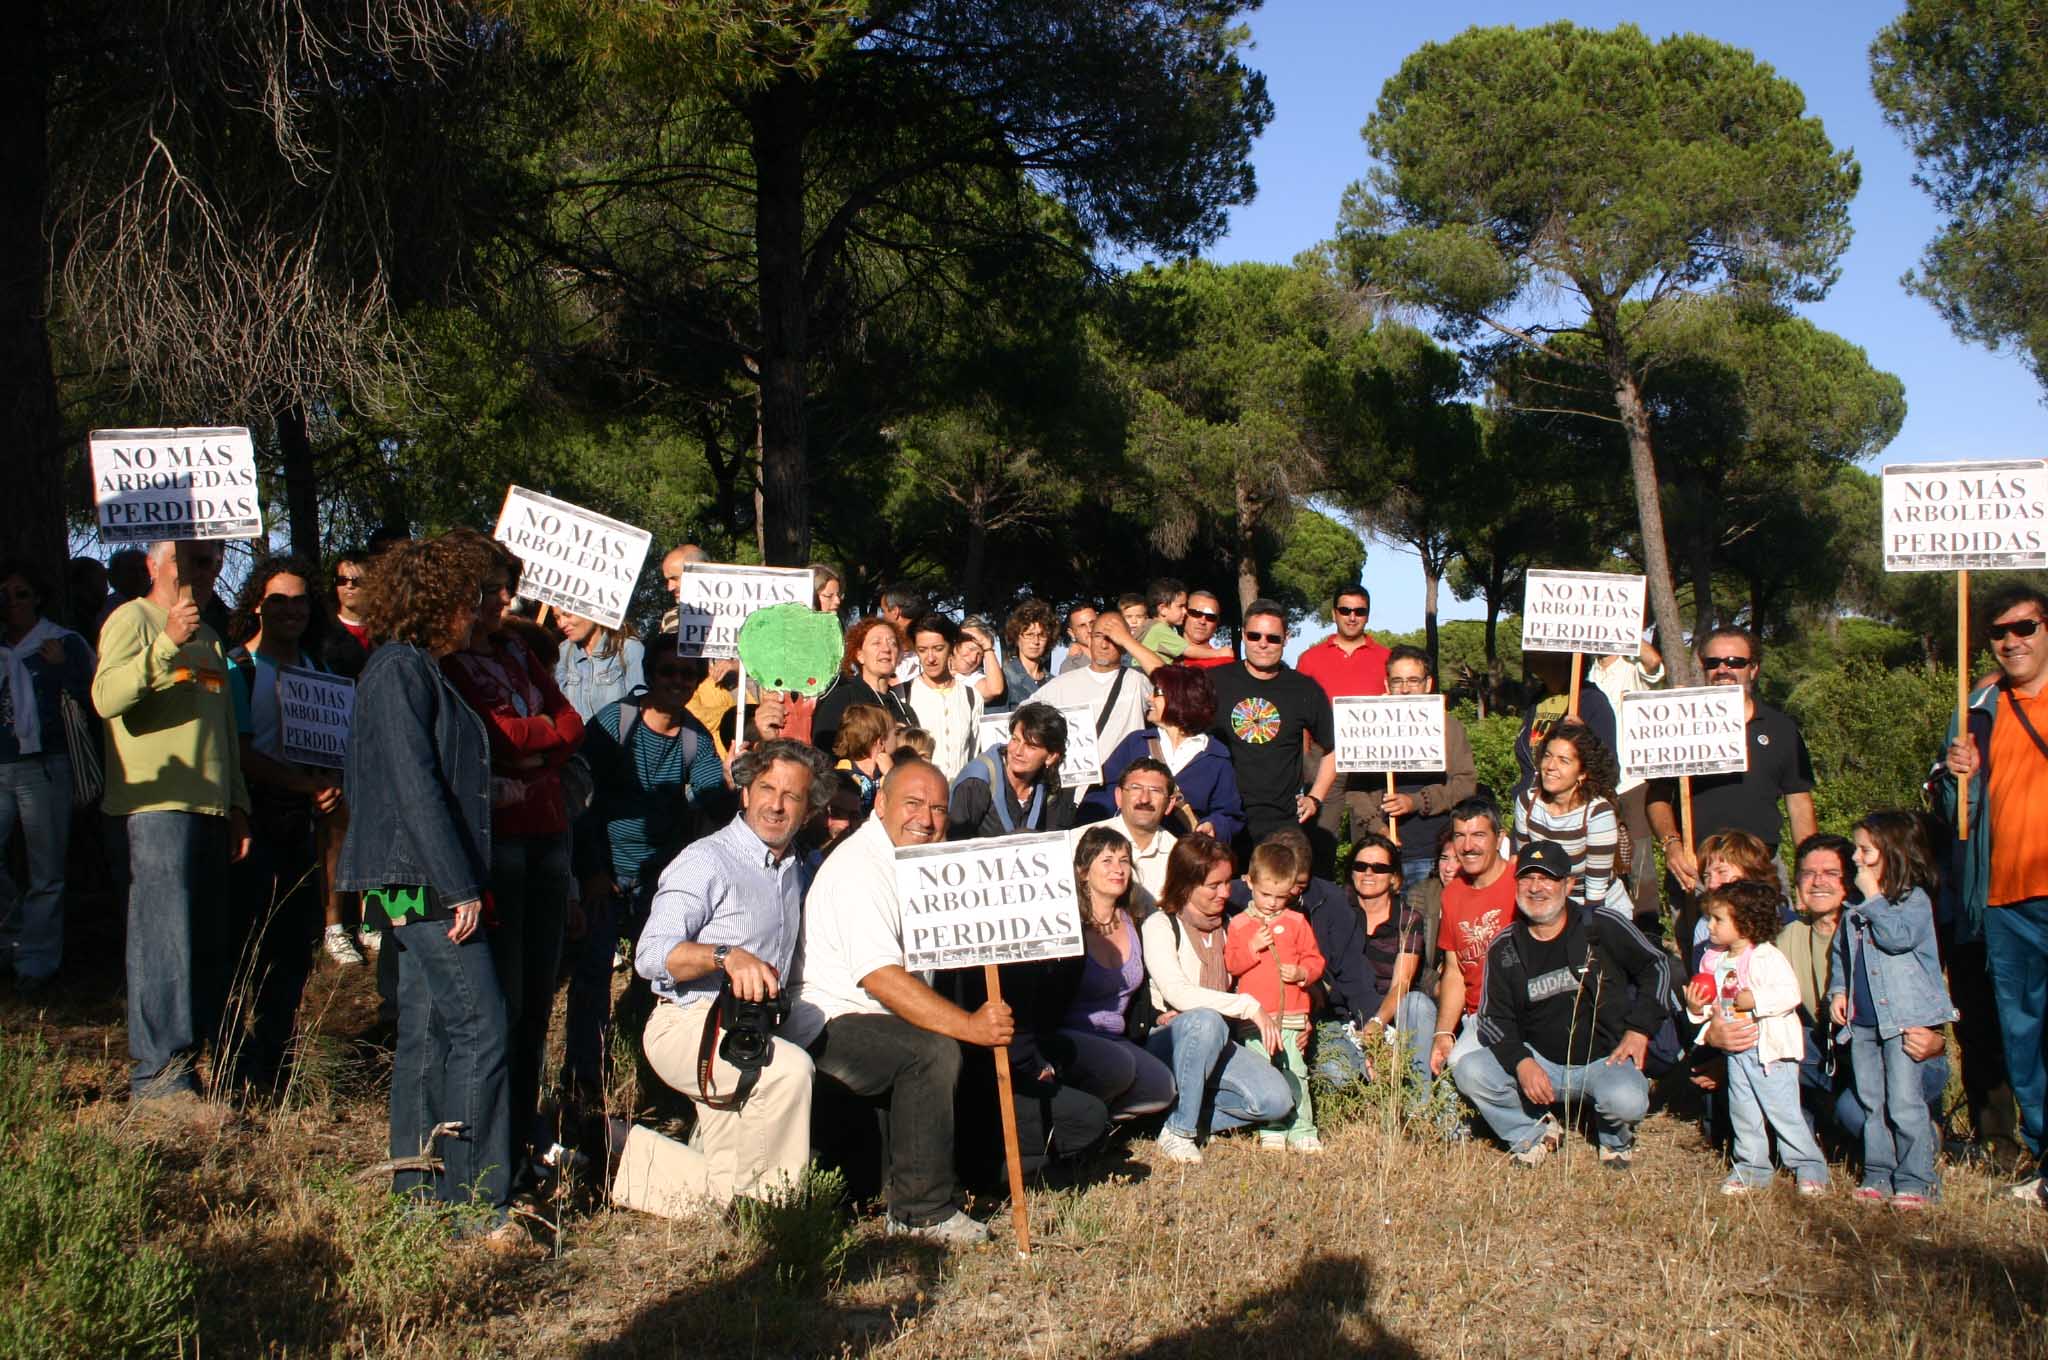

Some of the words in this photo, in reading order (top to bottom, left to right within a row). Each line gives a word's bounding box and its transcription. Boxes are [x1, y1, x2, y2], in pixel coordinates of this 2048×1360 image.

[112, 447, 157, 470] NO
[167, 439, 233, 468] MÁS
[100, 468, 253, 492] ARBOLEDAS
[1904, 480, 1948, 501] NO
[1958, 473, 2026, 500] MÁS
[106, 497, 252, 524] PERDIDAS
[1889, 502, 2045, 522] ARBOLEDAS
[521, 507, 562, 536] NO
[567, 523, 628, 560] MÁS
[1893, 530, 2041, 552] PERDIDAS
[499, 527, 636, 583] ARBOLEDAS
[524, 561, 622, 609] RDIDAS
[697, 580, 733, 599] NO
[742, 578, 795, 601] MÁS
[1540, 583, 1572, 600] NO
[1580, 582, 1629, 603] MÁS
[683, 600, 765, 618] ARBOL
[1529, 601, 1640, 619] ARBOLEDAS
[1530, 622, 1636, 641] PERDIDAS
[288, 681, 309, 702] NO
[313, 685, 345, 710] MÁS
[284, 703, 350, 728] ARBOLEDA
[1347, 708, 1377, 723] NO
[1384, 704, 1429, 722] MÁS
[1637, 704, 1670, 722] NO
[1678, 696, 1728, 719] MÁS
[287, 727, 346, 753] PERDIDA
[994, 727, 1008, 739] N
[1339, 725, 1441, 738] ARBOLEDAS
[1627, 720, 1742, 740] ARBOLEDAS
[1341, 745, 1440, 759] PERDIDAS
[1631, 742, 1740, 764] PERDIDAS
[918, 862, 966, 889] NO
[977, 849, 1049, 883] MÁS
[905, 879, 1072, 916] ARBOLEDAS
[912, 912, 1072, 950] PERDIDAS
